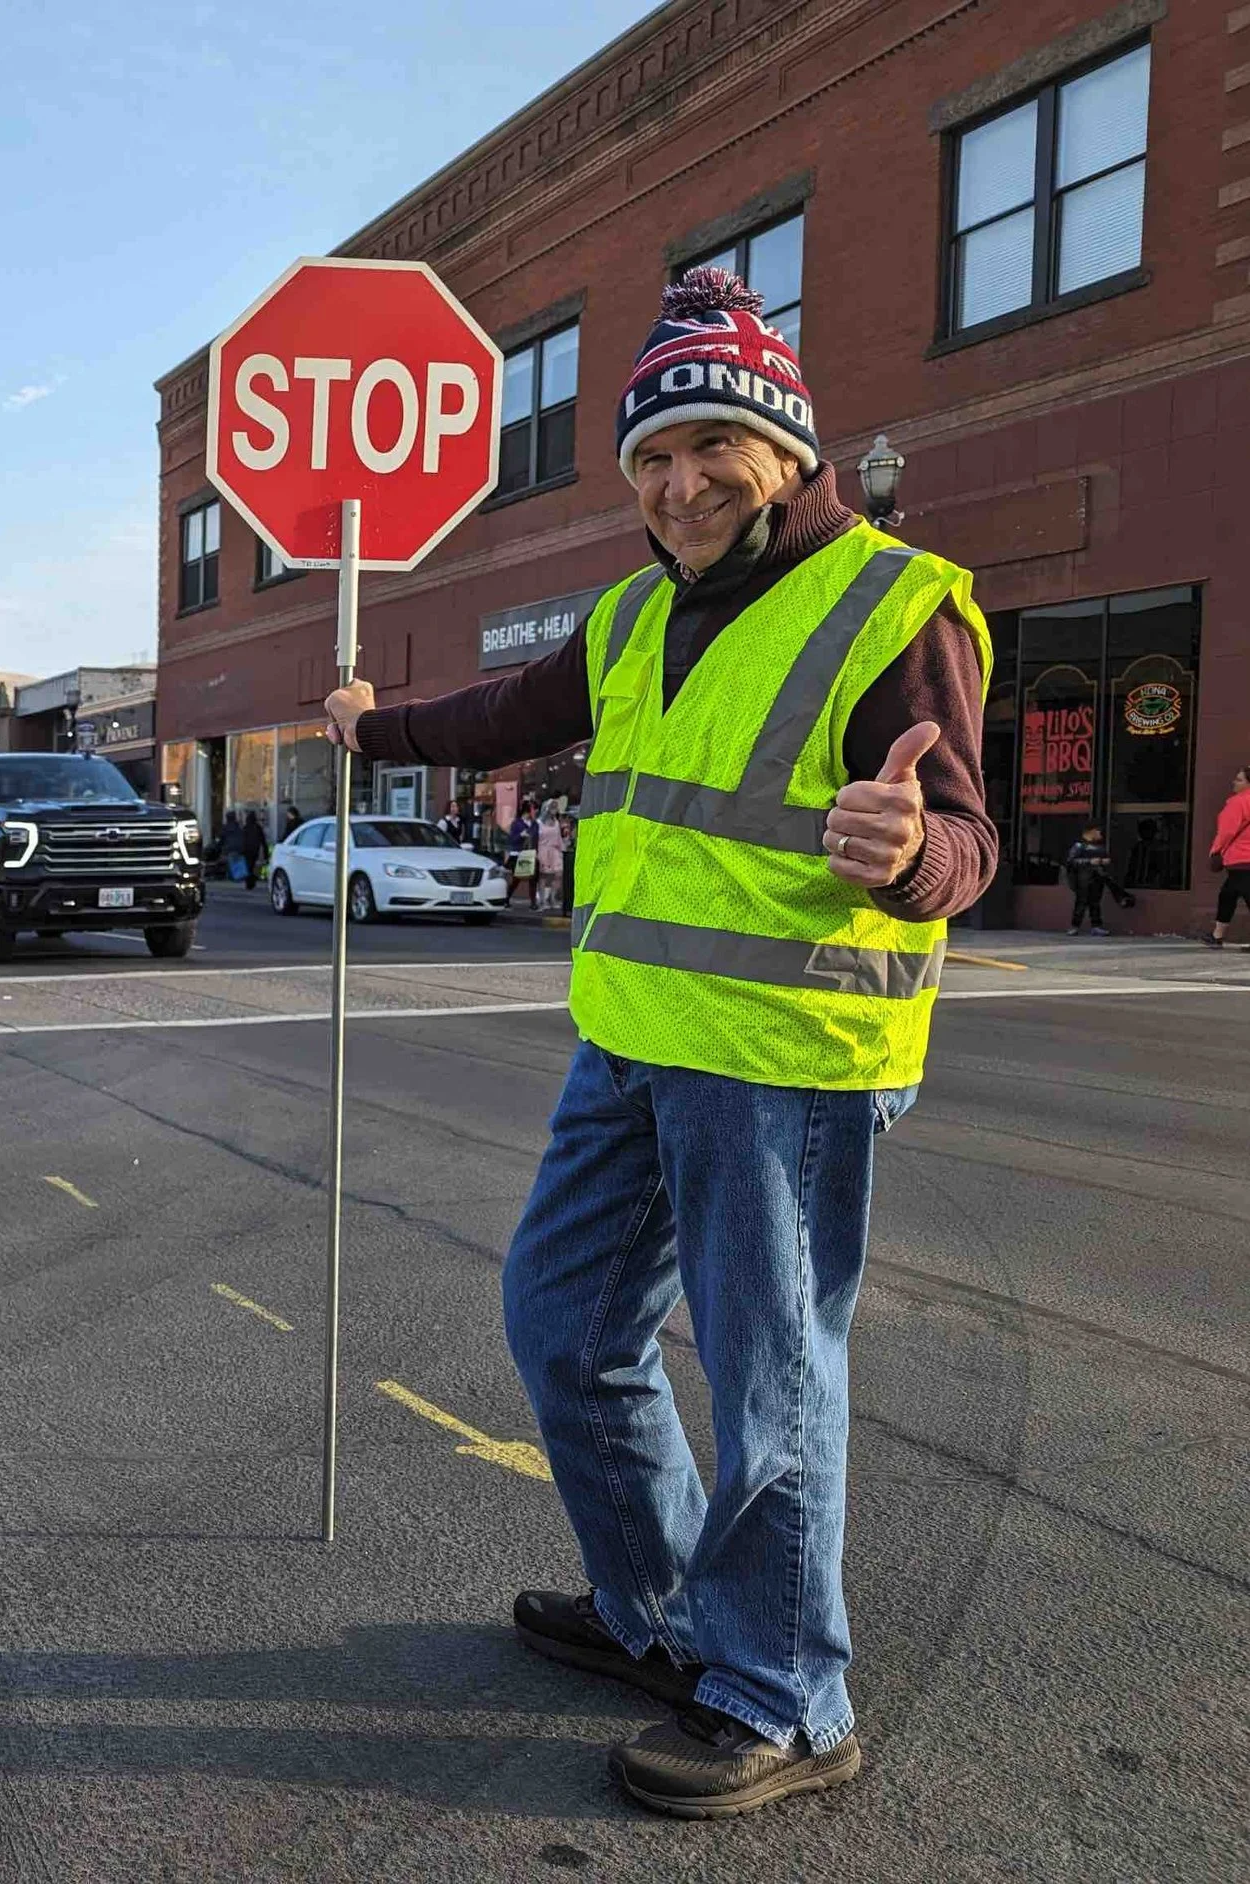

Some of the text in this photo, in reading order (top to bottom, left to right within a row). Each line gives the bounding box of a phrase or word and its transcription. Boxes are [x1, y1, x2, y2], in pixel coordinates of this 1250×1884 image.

[232, 354, 480, 474] STOP
[482, 620, 537, 653] BREATHE
[1046, 740, 1092, 773] BBQ
